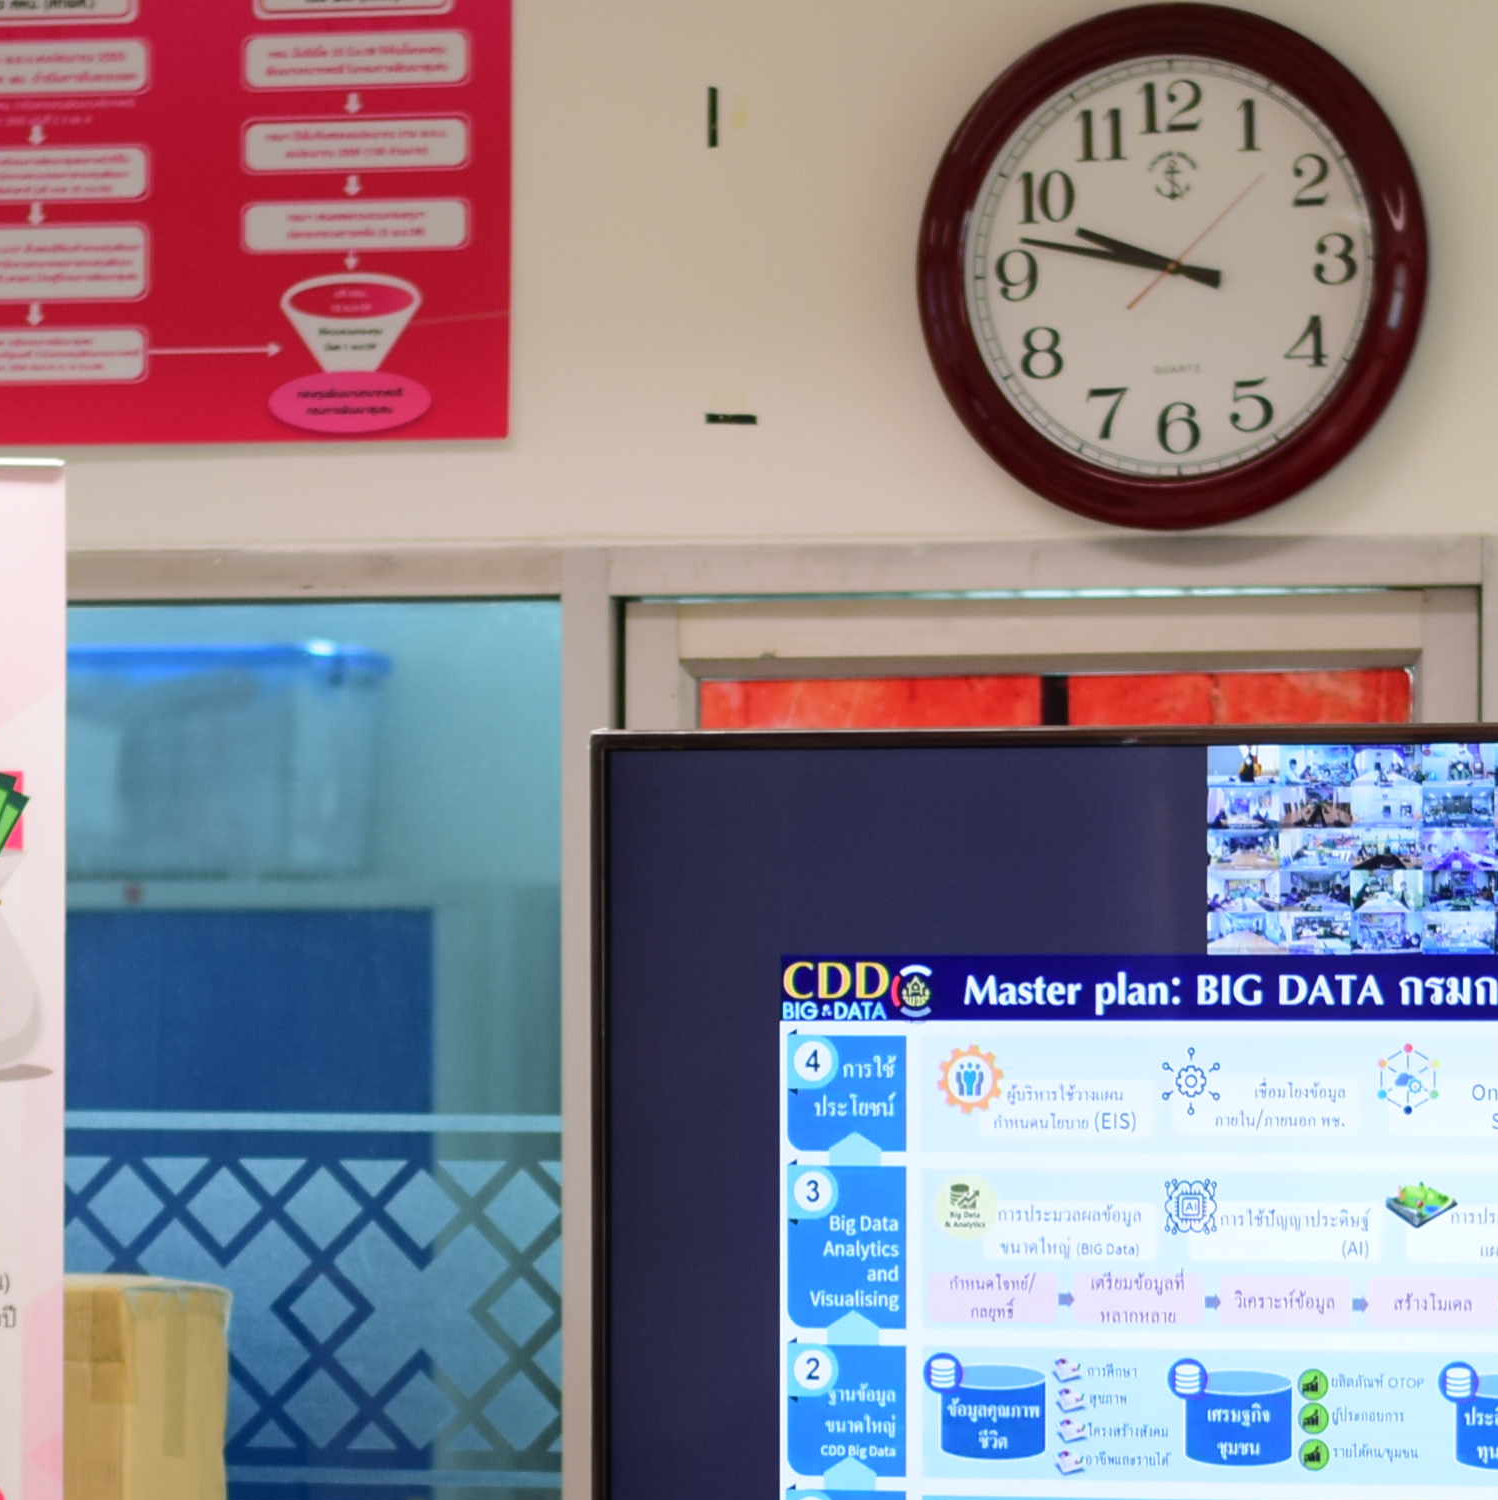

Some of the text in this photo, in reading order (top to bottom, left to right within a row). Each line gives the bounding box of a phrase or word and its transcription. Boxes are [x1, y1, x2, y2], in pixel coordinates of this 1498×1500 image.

[1139, 80, 1203, 133] 12
[1075, 108, 1128, 162] 11
[1237, 99, 1261, 151] 1
[1292, 154, 1329, 206] 2
[1017, 170, 1075, 224] 10
[1313, 233, 1357, 285] 3
[995, 248, 1038, 301] 9
[1021, 326, 1063, 379] 8
[1284, 315, 1328, 367] 4
[1153, 364, 1203, 374] QUARTZ
[1087, 387, 1128, 439] 7
[1229, 377, 1274, 431] 5
[1157, 402, 1201, 453] 6
[783, 961, 889, 999] CDD
[963, 974, 1082, 1007] Master
[1094, 971, 1181, 1016] plan:
[1197, 974, 1263, 1007] BIG
[1278, 974, 1385, 1007] DATA
[804, 1050, 821, 1073] 4
[842, 1054, 896, 1080] การใช้
[813, 1093, 896, 1119] ประโยชน์
[1094, 1110, 1136, 1133] (EIS)
[806, 1180, 820, 1202] 3
[1185, 1201, 1198, 1212] AI
[829, 1215, 899, 1237] Big Data
[824, 1240, 899, 1262] Analytics
[1106, 1242, 1140, 1258] Data)
[1341, 1240, 1370, 1259] (AI)
[867, 1265, 899, 1284] and
[809, 1289, 900, 1313] Visualising
[805, 1358, 820, 1380] 2
[1388, 1377, 1424, 1389] OTOP
[828, 1384, 896, 1410] ฐานข้อมูล
[825, 1413, 896, 1439] ขนาดใหญ่
[1207, 1404, 1270, 1427] เศรษฐกิจ
[820, 1444, 896, 1461] CDD Big Data
